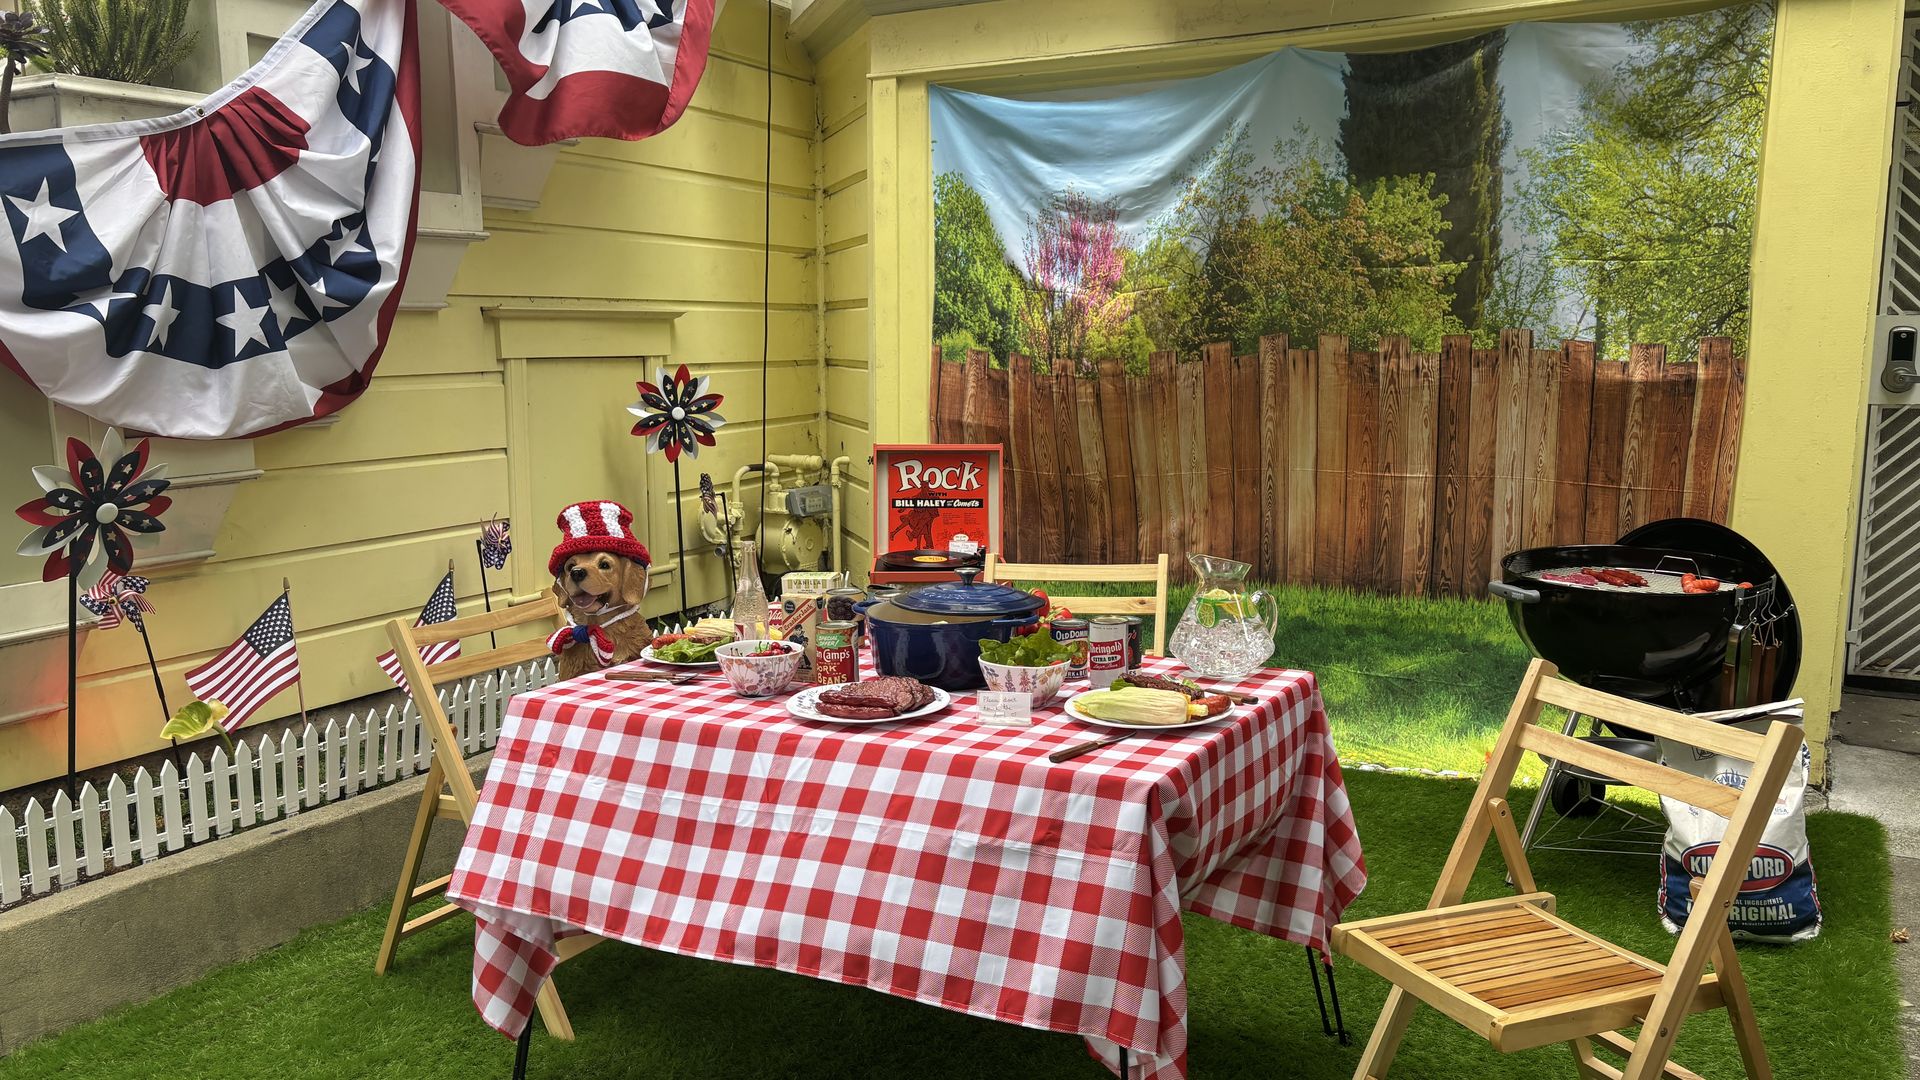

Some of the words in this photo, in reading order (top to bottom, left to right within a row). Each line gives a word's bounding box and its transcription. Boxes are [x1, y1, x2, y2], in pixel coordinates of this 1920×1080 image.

[895, 499, 914, 507] BILL
[917, 499, 945, 507] HALEY
[953, 499, 979, 508] Comets
[1056, 630, 1069, 641] OLD
[823, 649, 850, 662] Camp's
[817, 672, 847, 685] BEANS
[1745, 896, 1783, 906] INGREDIENTS
[1729, 903, 1797, 922] RIGINAL
